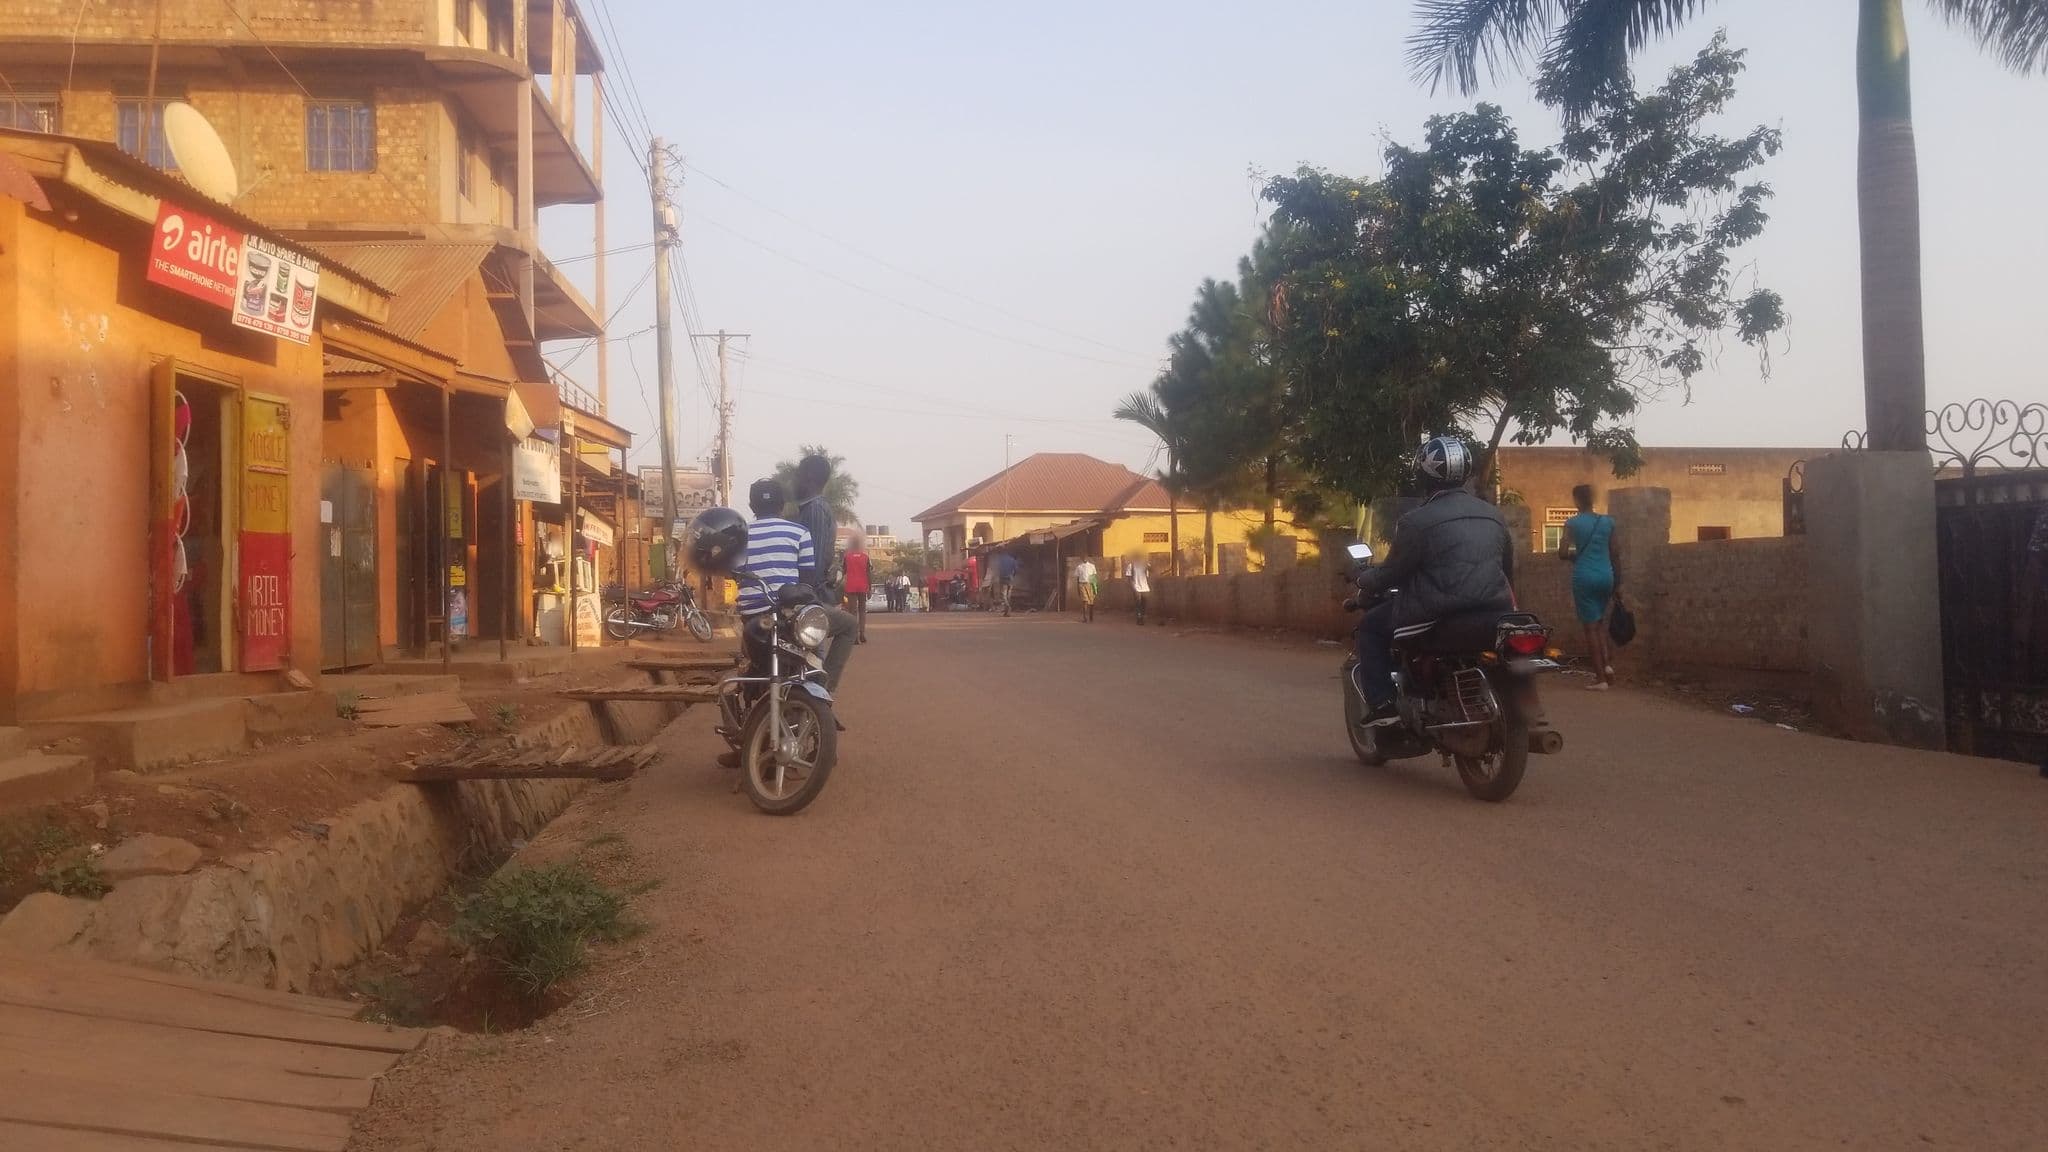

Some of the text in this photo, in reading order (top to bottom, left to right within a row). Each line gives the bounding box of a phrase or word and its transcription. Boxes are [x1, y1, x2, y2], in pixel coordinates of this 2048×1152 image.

[188, 225, 238, 276] airte
[258, 239, 276, 256] AUTO
[276, 246, 296, 263] SPARE
[296, 254, 302, 266] &
[302, 256, 320, 274] PAINT
[154, 257, 170, 273] THE
[169, 263, 215, 289] SMARTPHONE
[248, 484, 283, 512] MONEY
[248, 575, 282, 606] AIRTEL
[248, 607, 284, 636] MONEY
